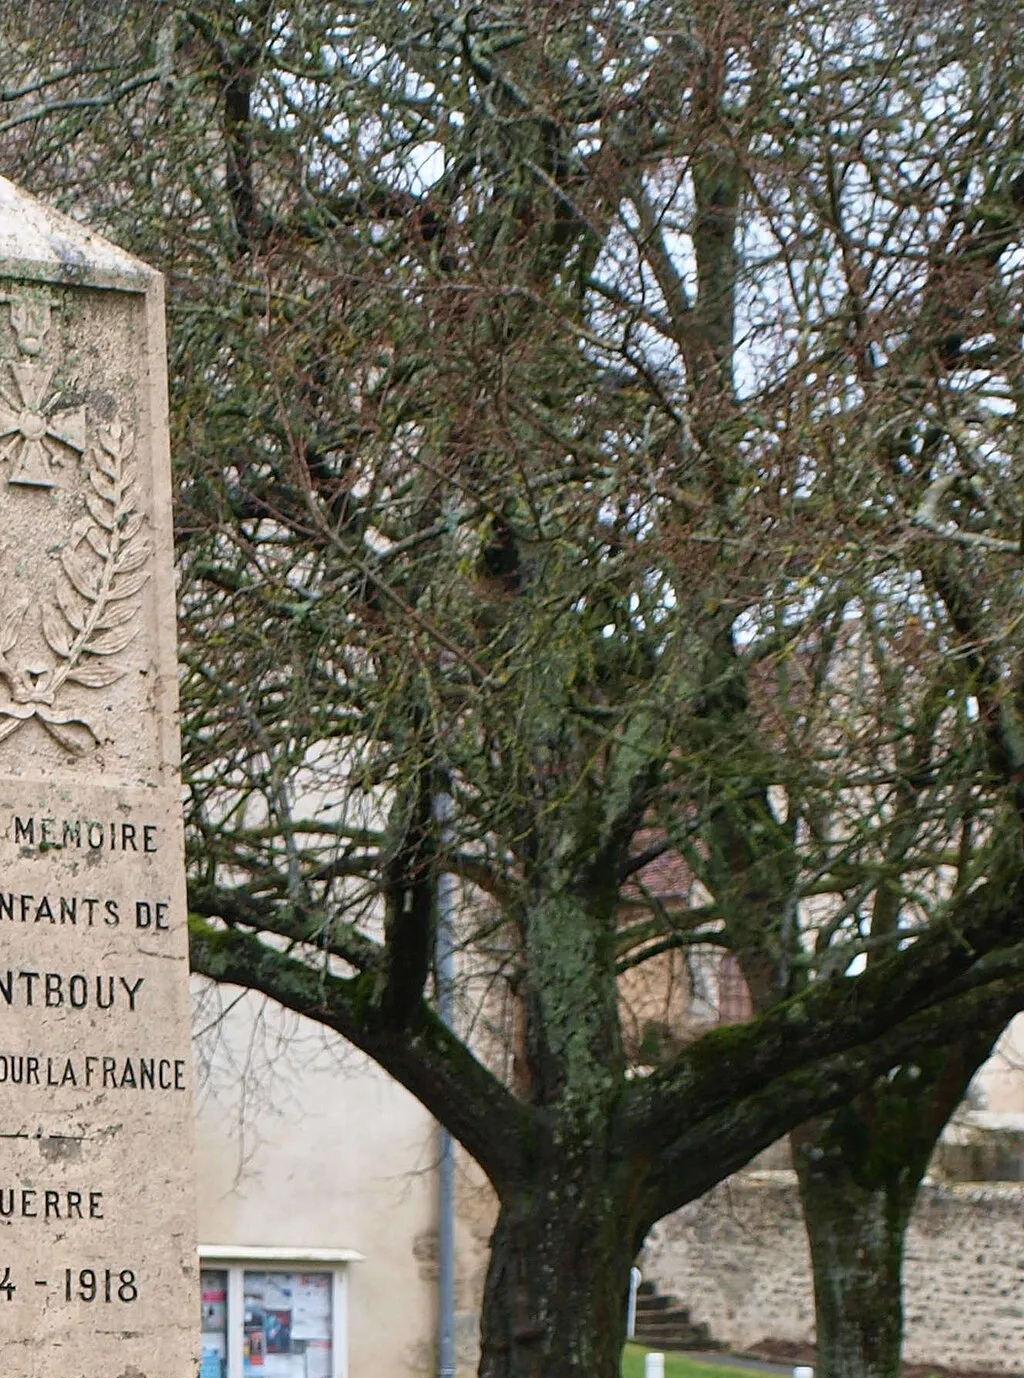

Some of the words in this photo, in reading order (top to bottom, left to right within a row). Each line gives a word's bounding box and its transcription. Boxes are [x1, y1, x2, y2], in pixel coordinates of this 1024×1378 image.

[135, 901, 170, 931] DE
[46, 1056, 77, 1087] LA
[84, 1057, 187, 1091] FRANCE
[64, 1268, 139, 1303] 1918
